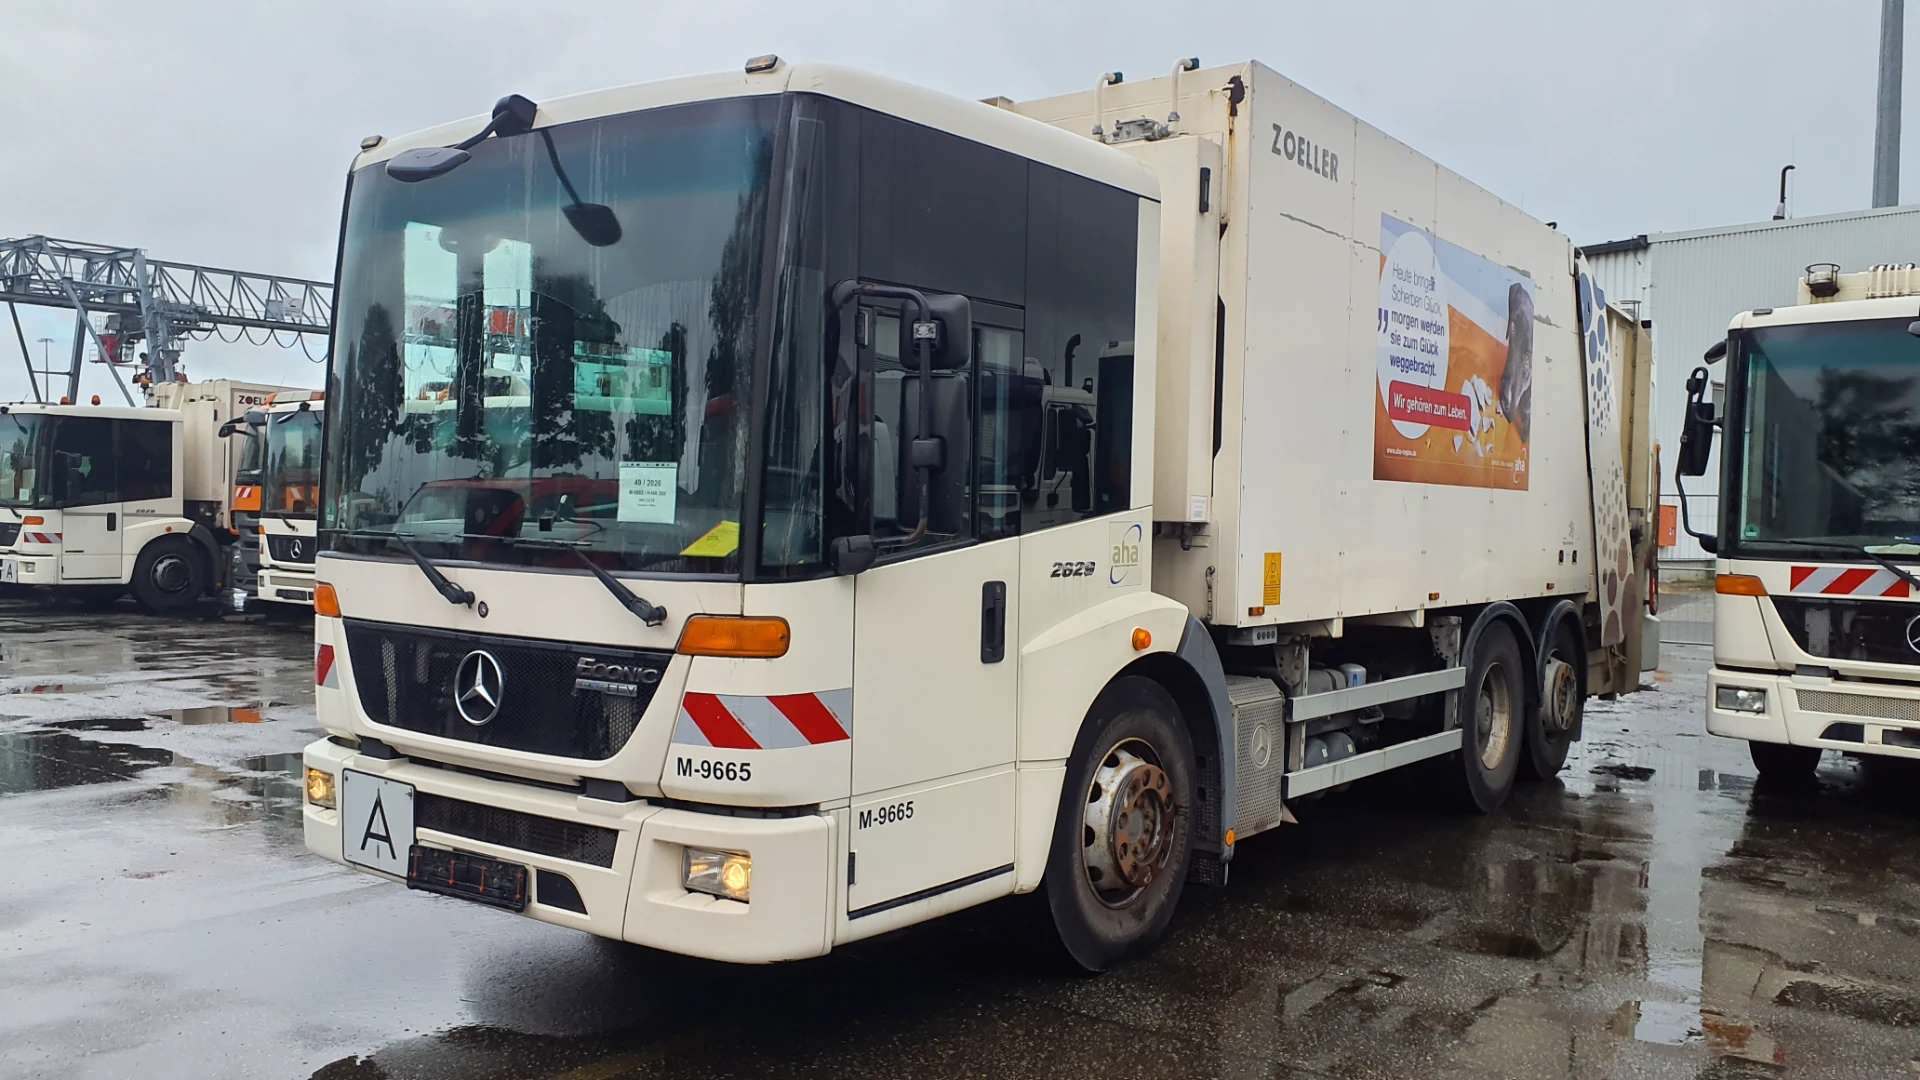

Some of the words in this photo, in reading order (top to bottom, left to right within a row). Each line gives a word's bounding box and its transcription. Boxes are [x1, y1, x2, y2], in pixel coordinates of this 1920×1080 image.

[1271, 122, 1339, 183] ZOELLER
[1392, 262, 1412, 284] Heute
[1391, 284, 1422, 309] Scherben
[1391, 310, 1419, 330] morgen
[1420, 318, 1445, 336] werden
[1390, 330, 1401, 346] sie
[1403, 335, 1418, 351] zum
[1419, 337, 1439, 356] Glück
[1389, 354, 1437, 377] weggebracht.
[1393, 392, 1405, 409] Wir
[1407, 396, 1432, 413] gehören
[1433, 404, 1447, 416] zum
[1447, 403, 1467, 420] Leben.
[1112, 541, 1139, 564] aha
[6, 563, 13, 579] A
[676, 757, 751, 782] M-9665
[360, 786, 397, 861] A
[858, 800, 914, 830] M-9665
